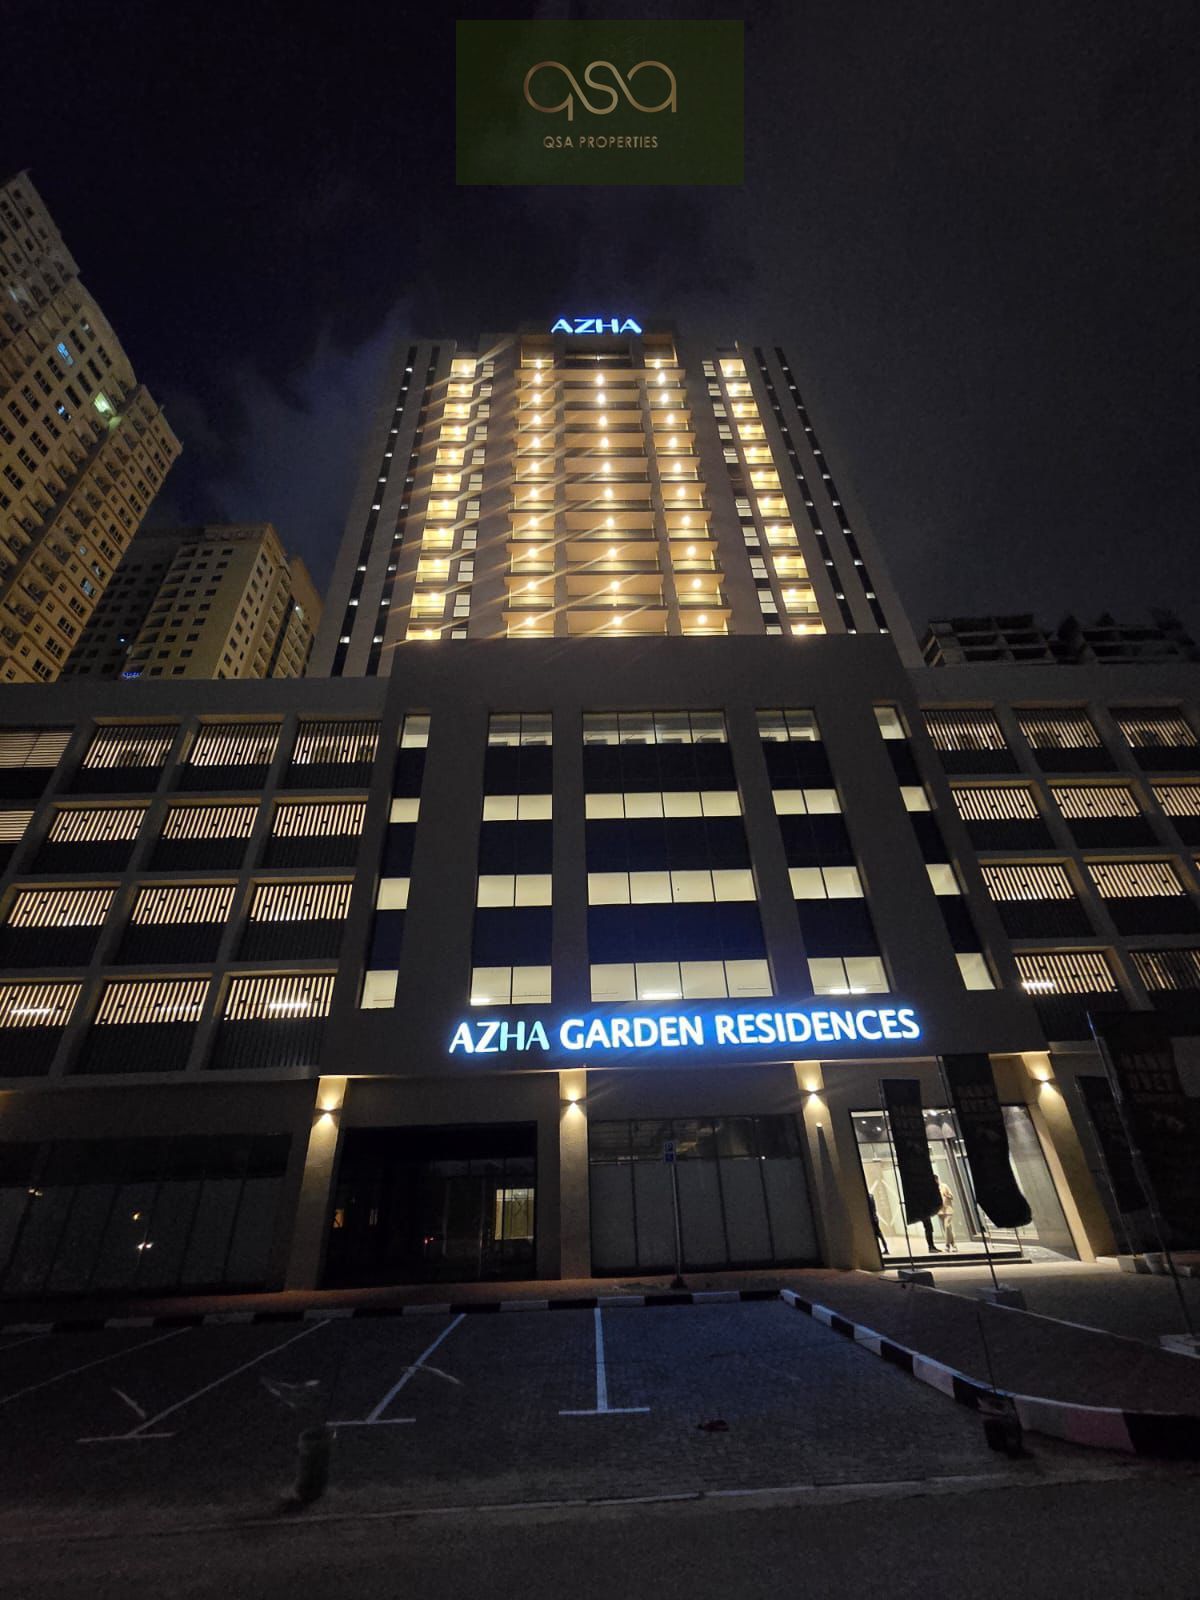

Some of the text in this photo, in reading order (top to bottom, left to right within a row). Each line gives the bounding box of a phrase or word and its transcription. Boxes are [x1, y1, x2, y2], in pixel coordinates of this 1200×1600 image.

[550, 318, 643, 334] AZHA
[448, 1008, 921, 1054] AZHA GARDEN RESIDENCES
